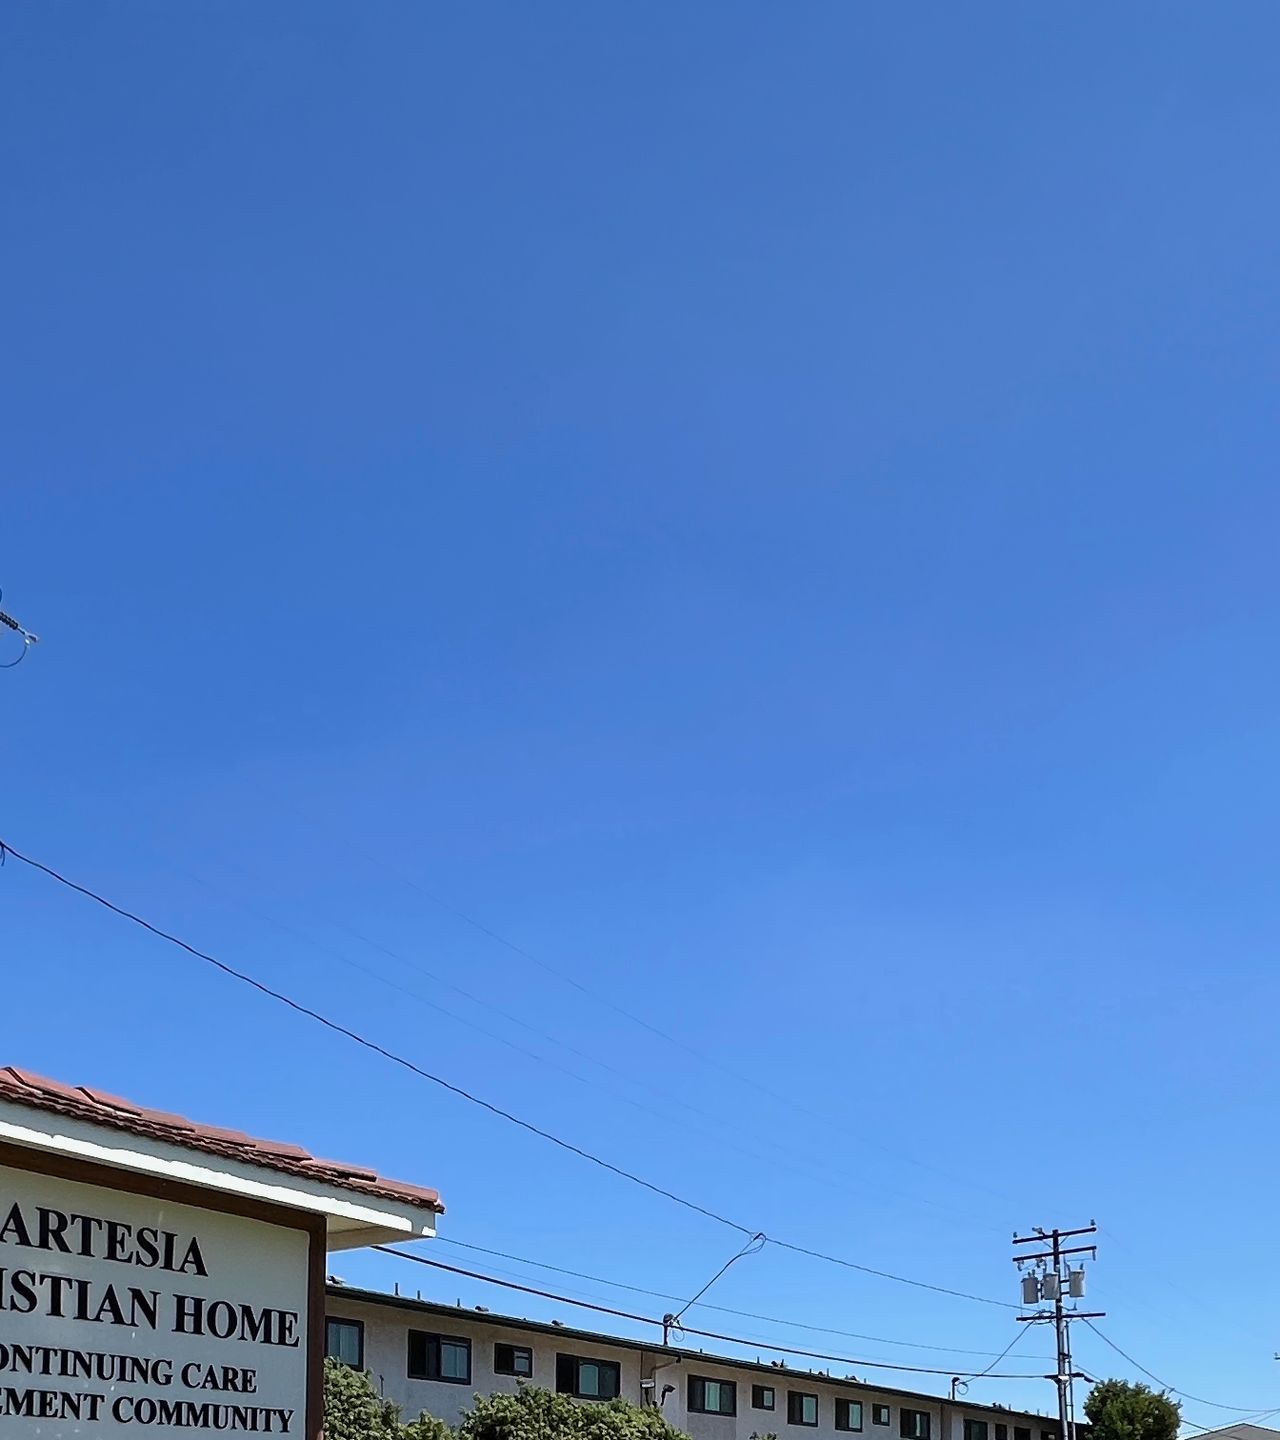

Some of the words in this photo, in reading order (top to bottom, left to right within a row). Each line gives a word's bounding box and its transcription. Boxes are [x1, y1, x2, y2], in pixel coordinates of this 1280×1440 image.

[172, 1292, 301, 1349] HOME
[180, 1362, 258, 1394] CARE
[111, 1395, 295, 1434] COMMUNITY
